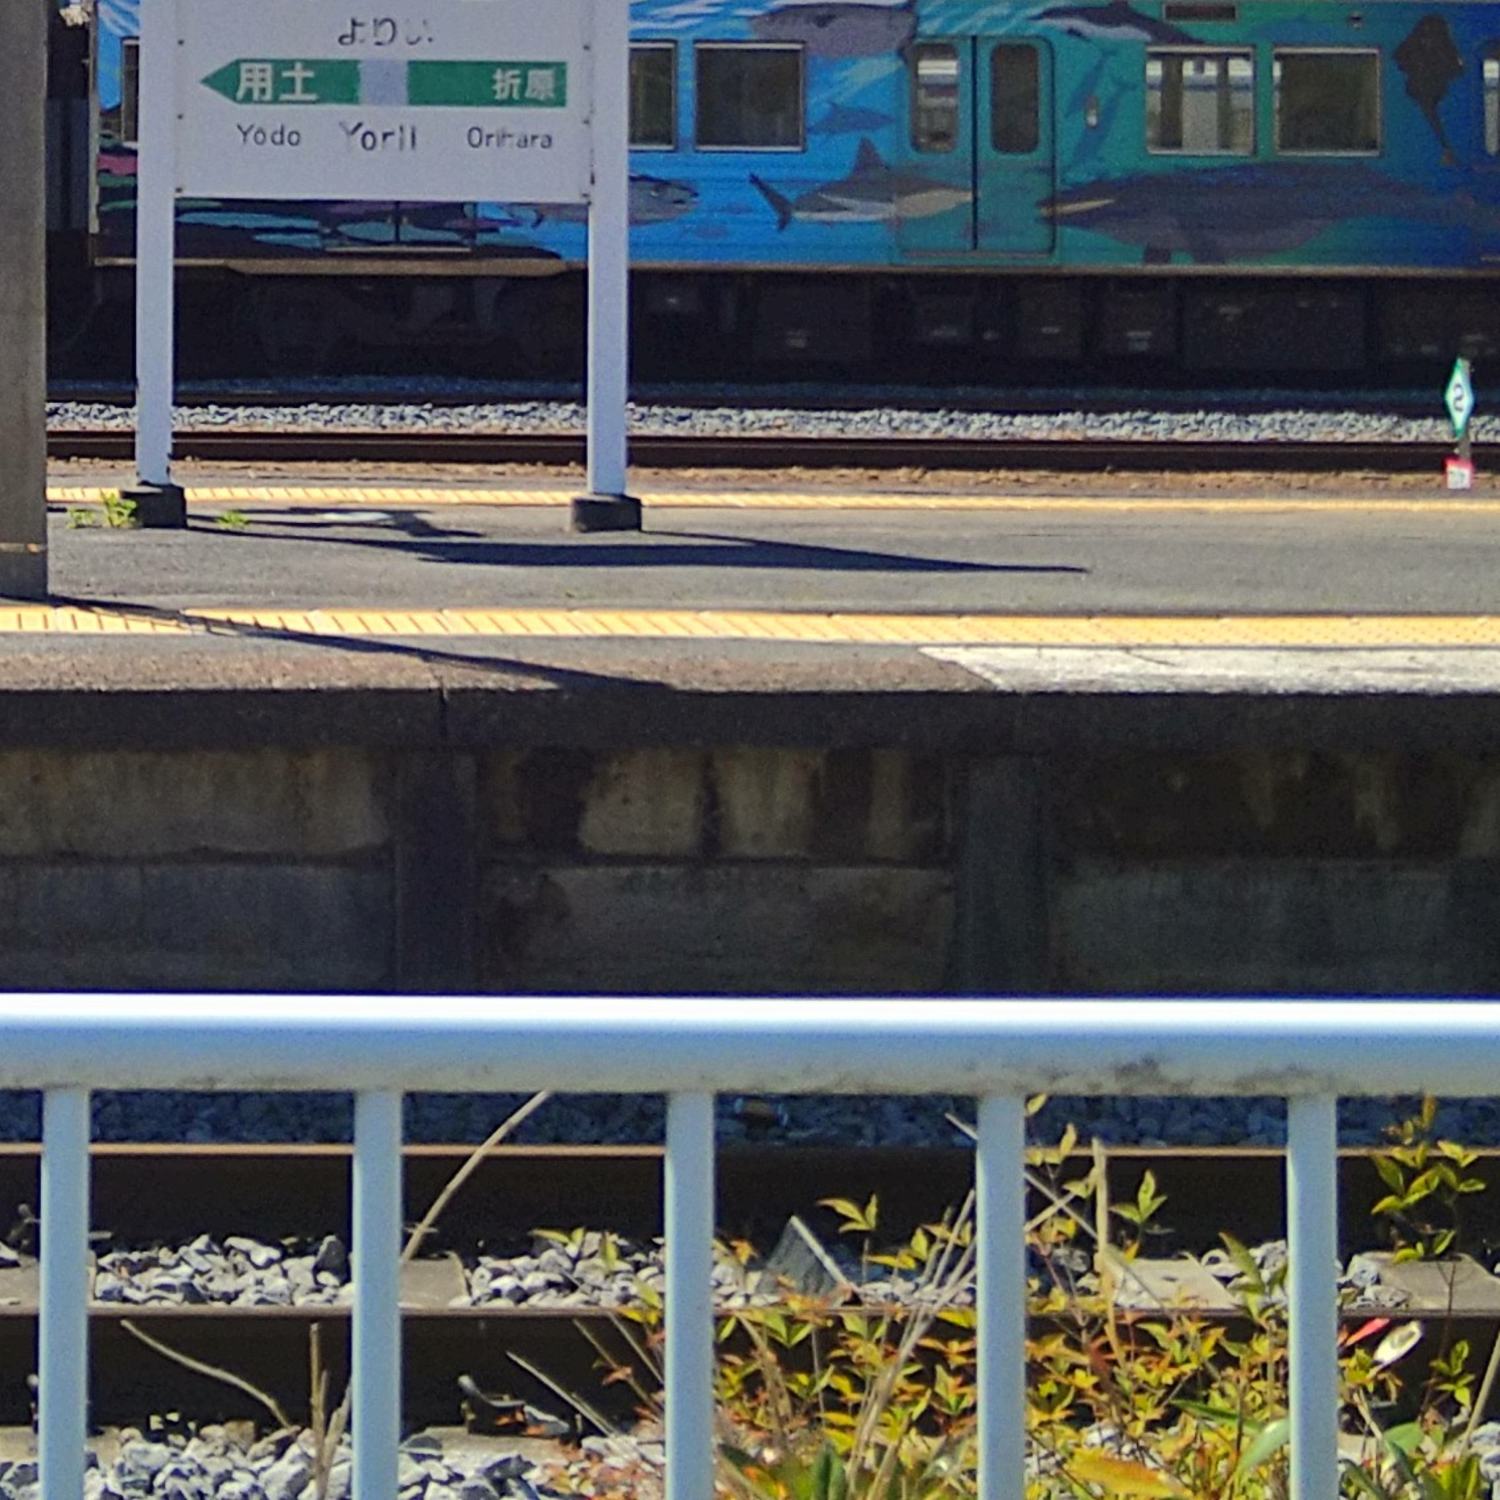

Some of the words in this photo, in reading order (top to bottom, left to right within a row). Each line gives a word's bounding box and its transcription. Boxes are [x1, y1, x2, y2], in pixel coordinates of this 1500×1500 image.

[236, 62, 318, 101] 用土
[492, 67, 555, 100] 折原
[237, 123, 301, 146] Yodo
